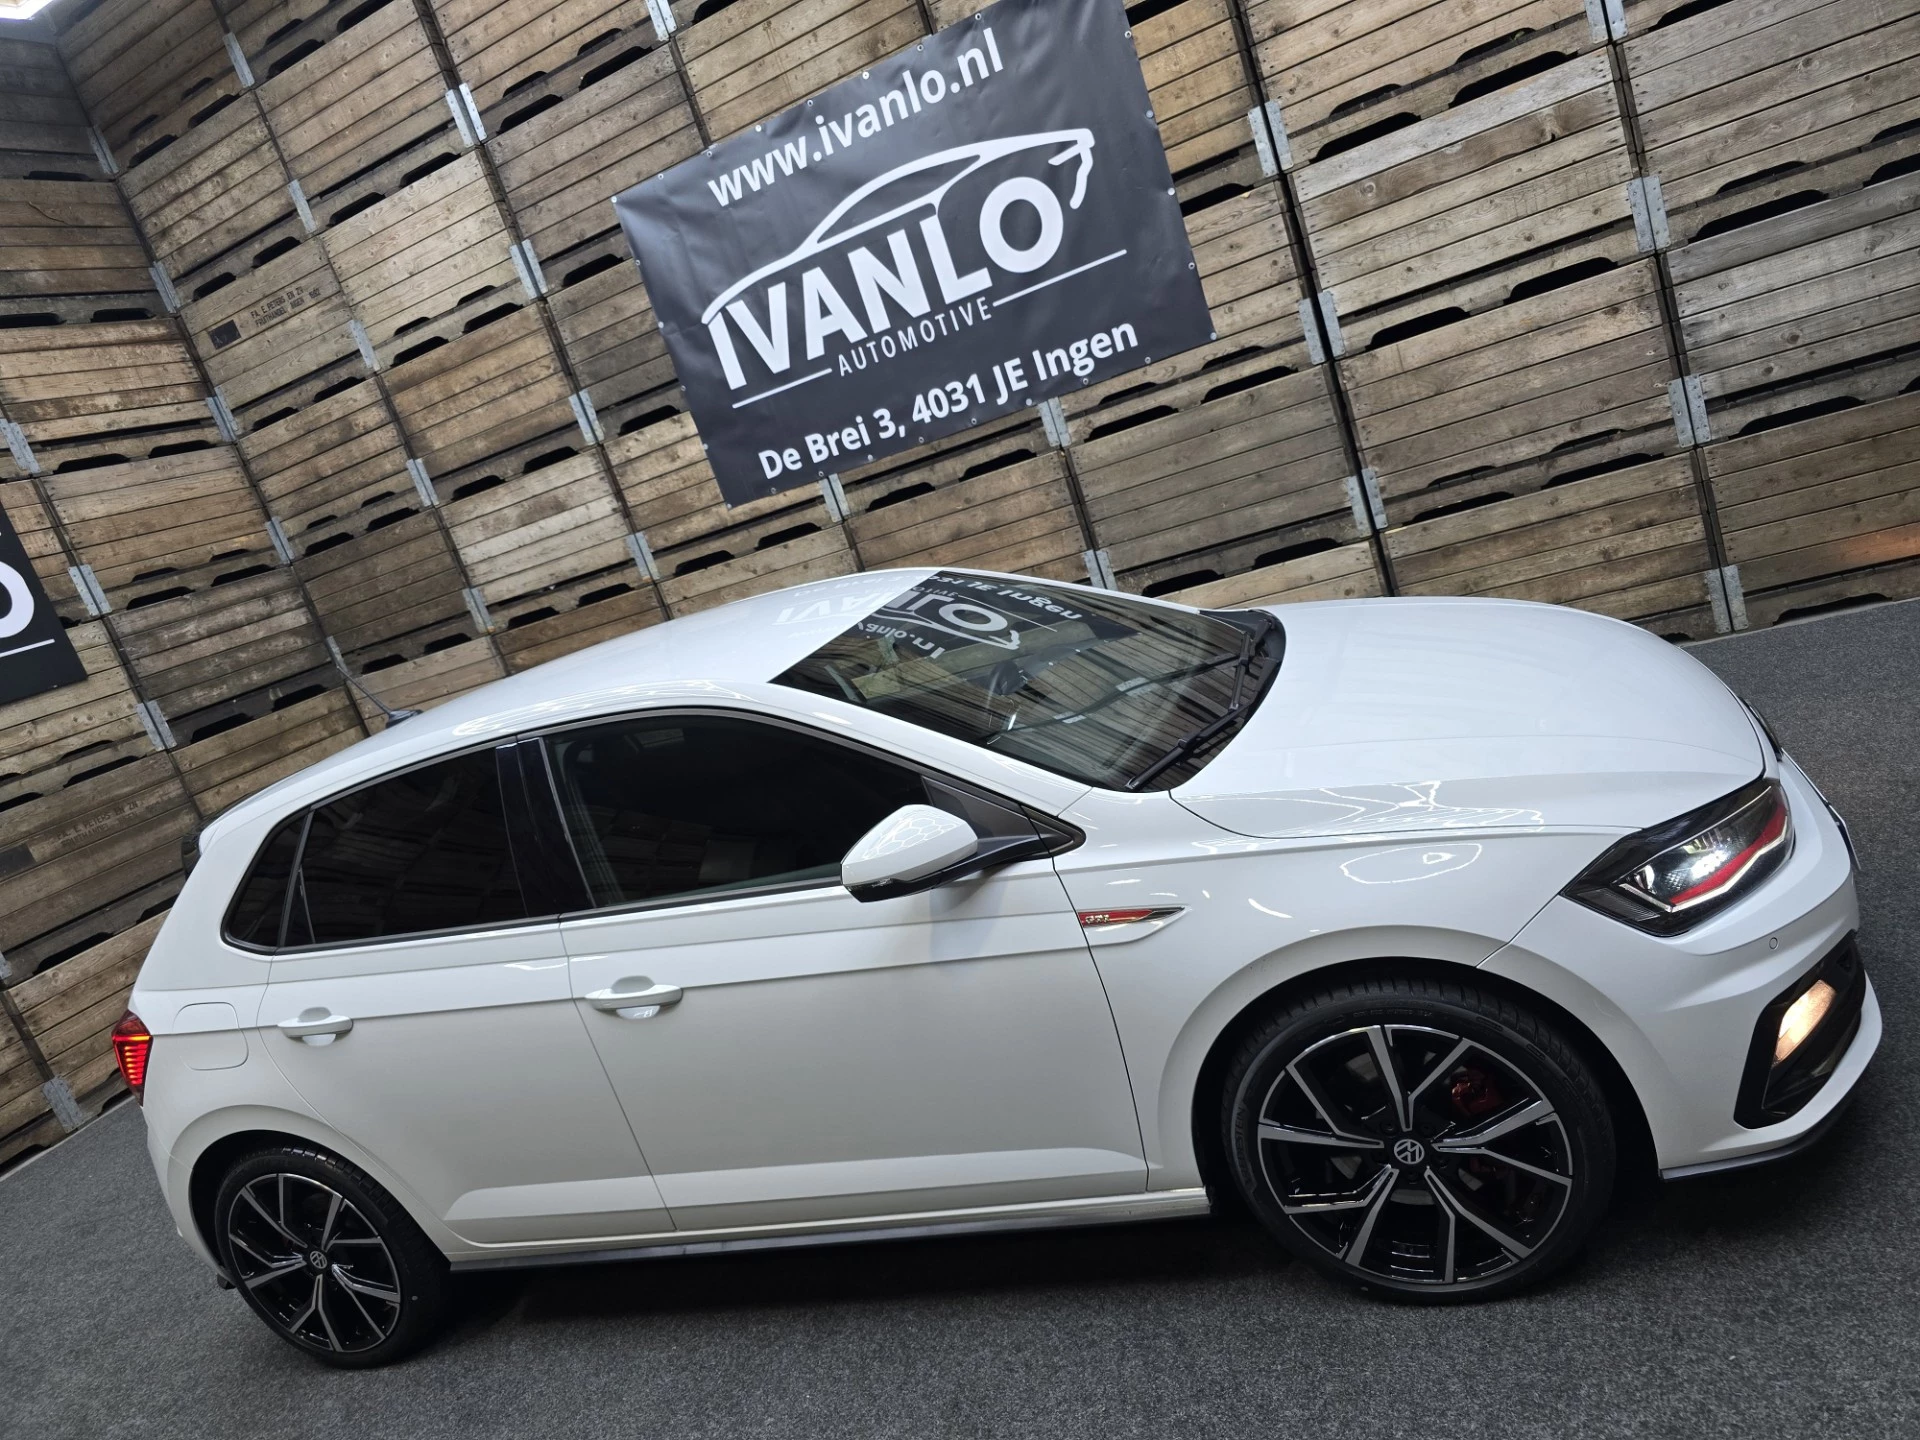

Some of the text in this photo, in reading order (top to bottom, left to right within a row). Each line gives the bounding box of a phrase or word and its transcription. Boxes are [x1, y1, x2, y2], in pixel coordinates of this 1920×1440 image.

[707, 27, 1004, 207] www.ivanlo.nl
[708, 176, 1064, 390] IVANLO
[838, 296, 991, 377] AUTOMOTIVE
[758, 321, 1138, 479] De Brei 3, 4031 JE Ingen
[1085, 914, 1110, 924] GTI
